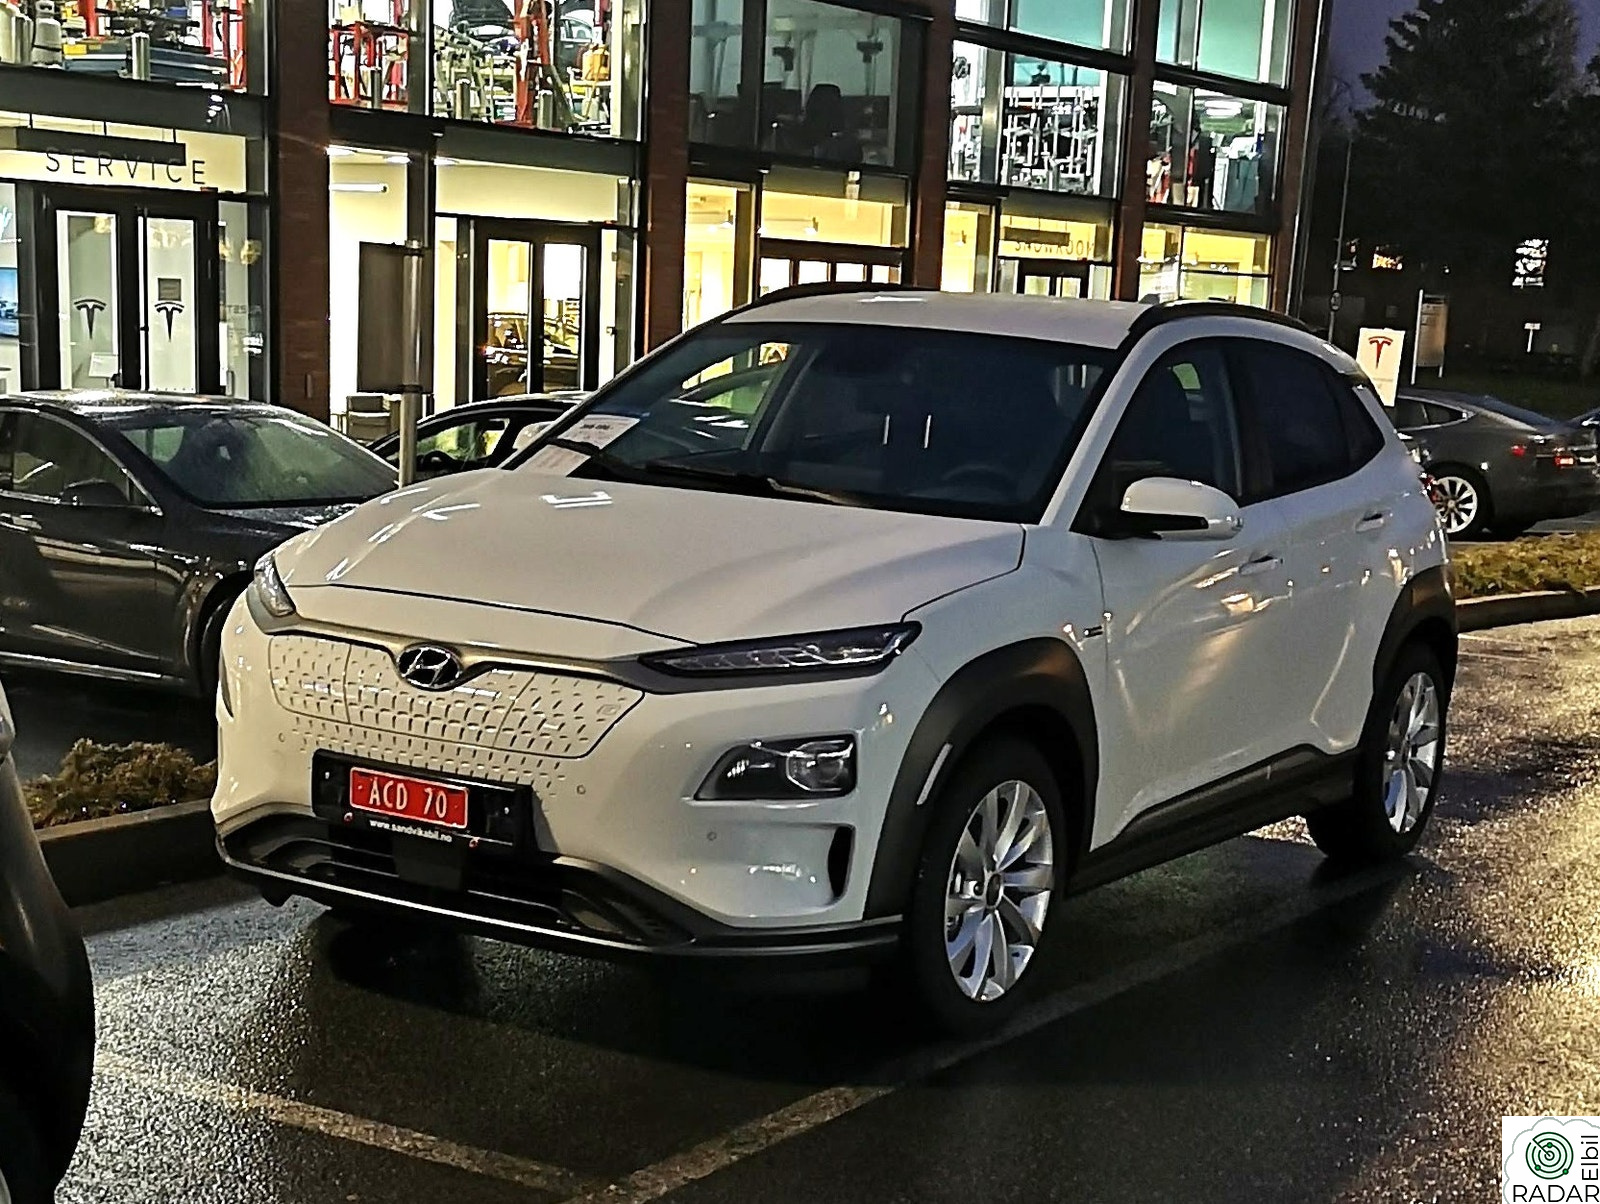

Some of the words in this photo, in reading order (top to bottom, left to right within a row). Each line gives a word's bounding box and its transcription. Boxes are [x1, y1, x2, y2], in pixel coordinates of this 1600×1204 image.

[45, 147, 208, 186] SERVICE
[368, 776, 408, 811] ACD
[423, 787, 448, 819] 70
